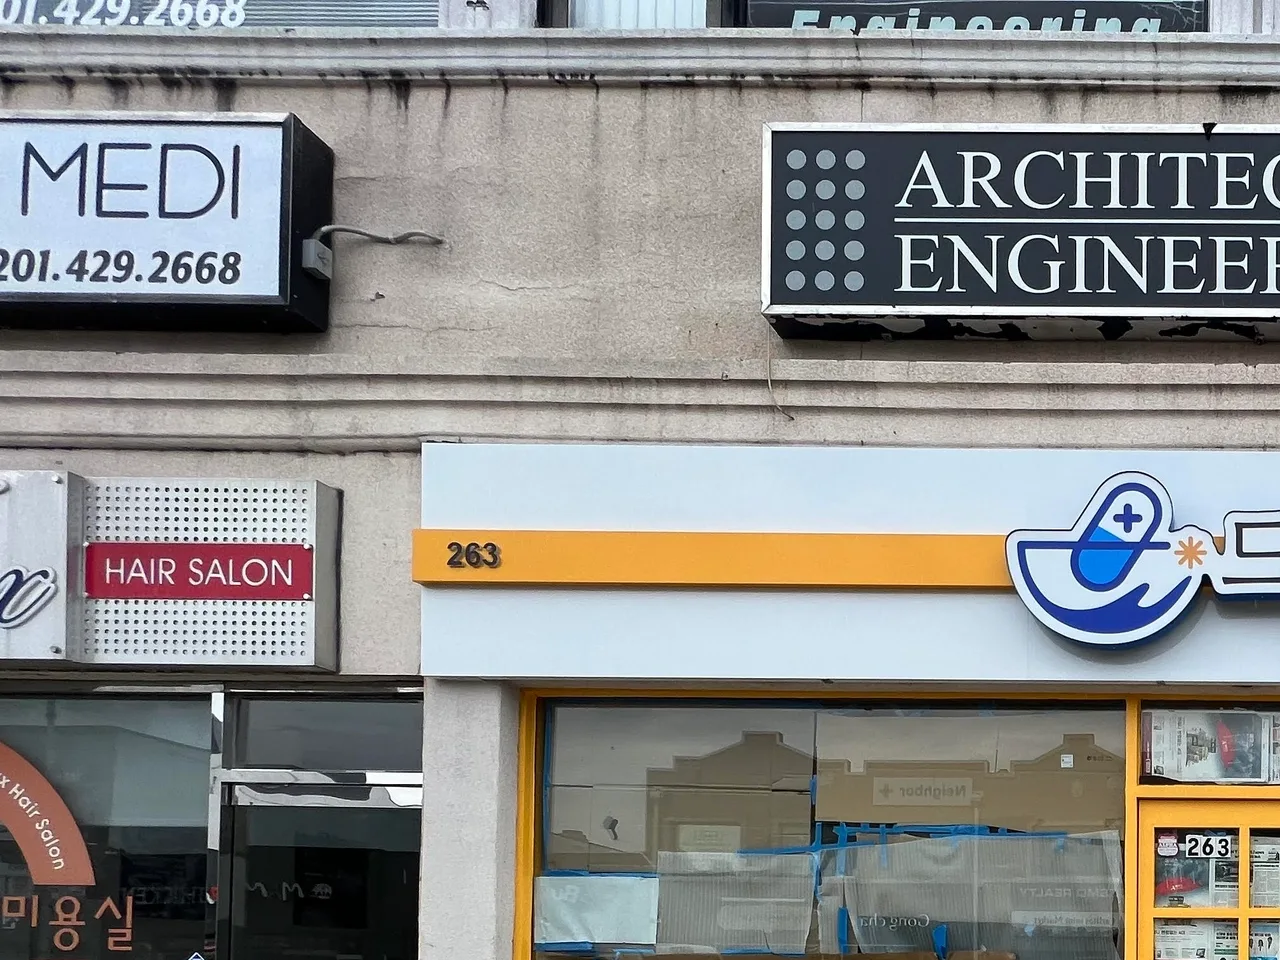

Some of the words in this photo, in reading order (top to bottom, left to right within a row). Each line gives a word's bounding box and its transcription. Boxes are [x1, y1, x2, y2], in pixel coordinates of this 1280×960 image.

[21, 141, 241, 220] MEDI
[105, 558, 176, 585] HAIR
[188, 558, 293, 586] SALON
[446, 541, 500, 568] 263
[8, 783, 41, 818] Hair
[35, 818, 65, 870] Salon
[1187, 837, 1230, 857] 263
[2, 895, 133, 951] 미용실
